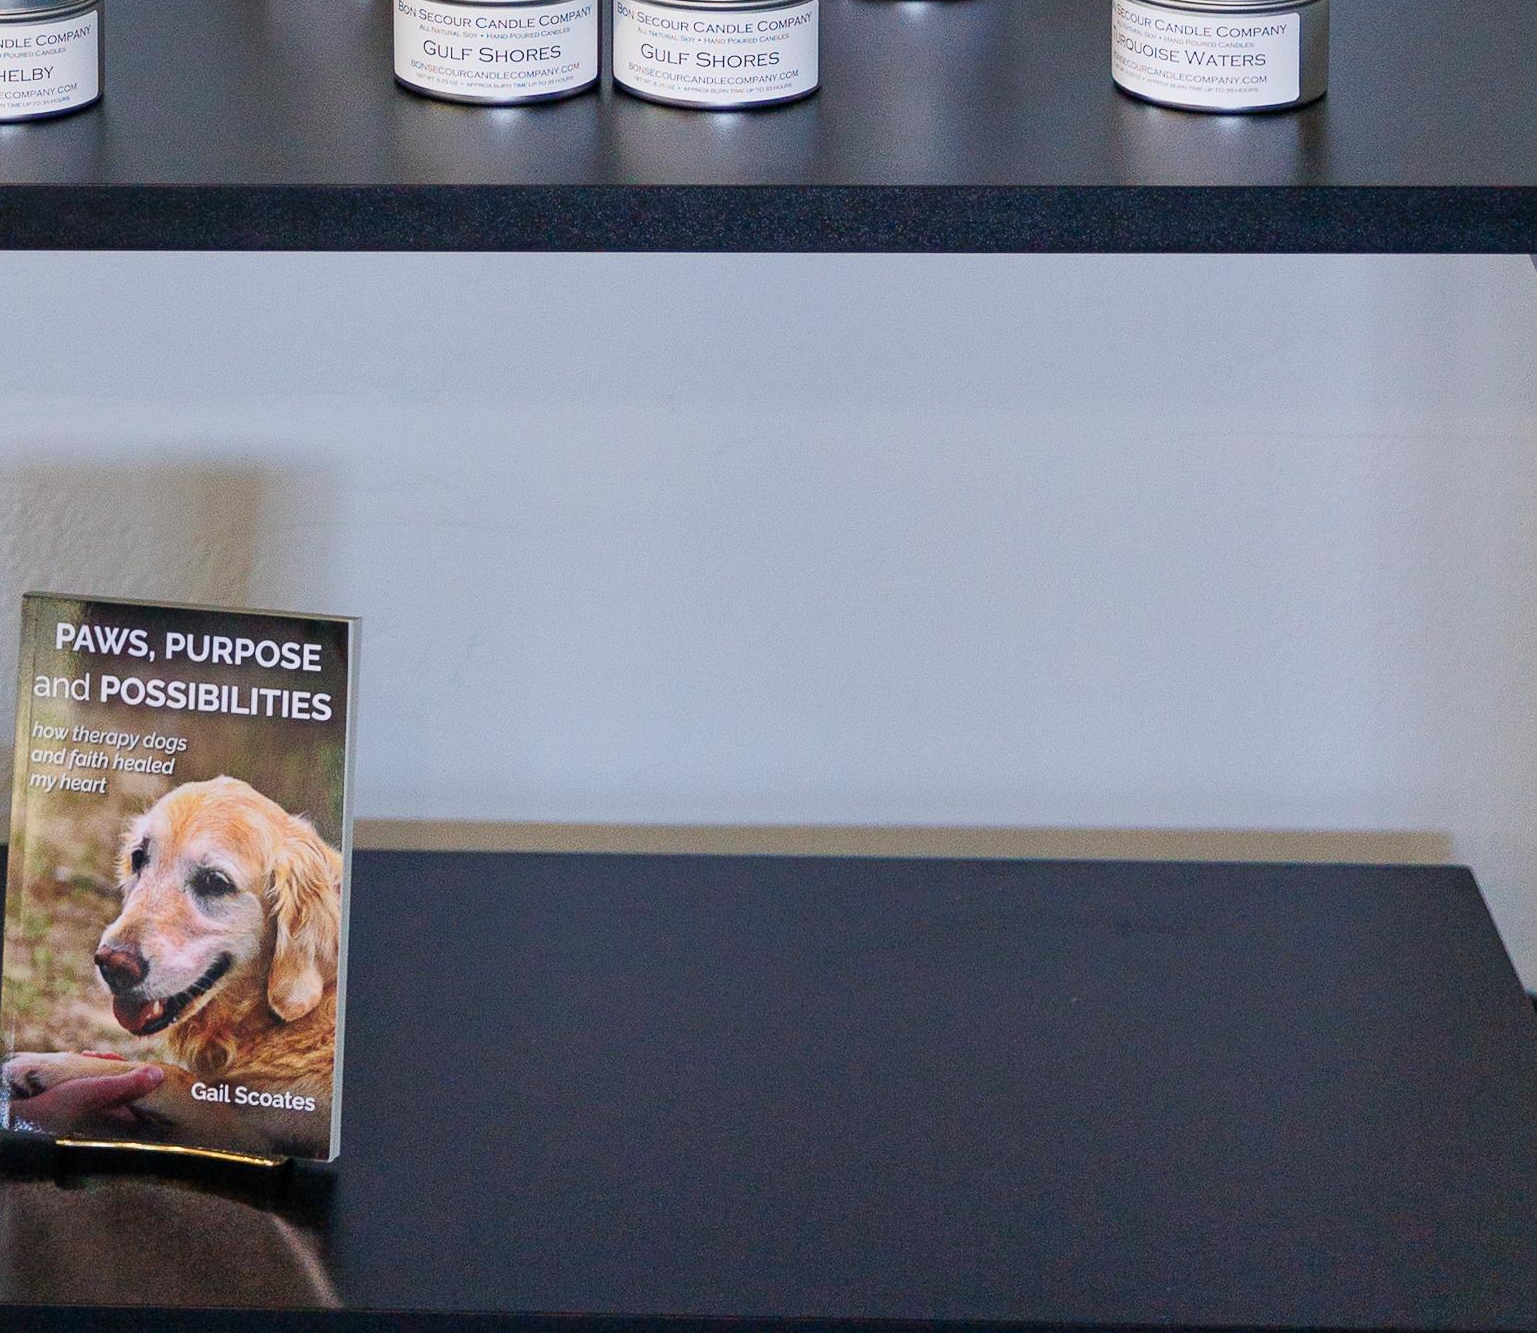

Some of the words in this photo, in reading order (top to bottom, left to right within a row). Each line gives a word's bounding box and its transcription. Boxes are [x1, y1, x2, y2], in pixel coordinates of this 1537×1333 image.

[423, 40, 473, 61] GULF
[478, 46, 561, 63] SHORES
[640, 43, 690, 65] GULF
[695, 52, 780, 68] SHORES
[1185, 50, 1267, 67] WATERS
[55, 621, 155, 663] PAWS,
[165, 632, 323, 673] PURPOSE
[33, 673, 91, 701] and
[100, 675, 333, 722] POSSIBILITIES
[31, 721, 68, 741] how
[71, 725, 141, 751] therapy
[143, 732, 187, 753] dogs
[31, 749, 65, 765] and
[68, 751, 109, 769] faith
[112, 755, 175, 775] healed
[29, 773, 57, 793] my
[60, 773, 107, 794] heart
[191, 1082, 231, 1103] Gail
[234, 1086, 316, 1111] Scoates
